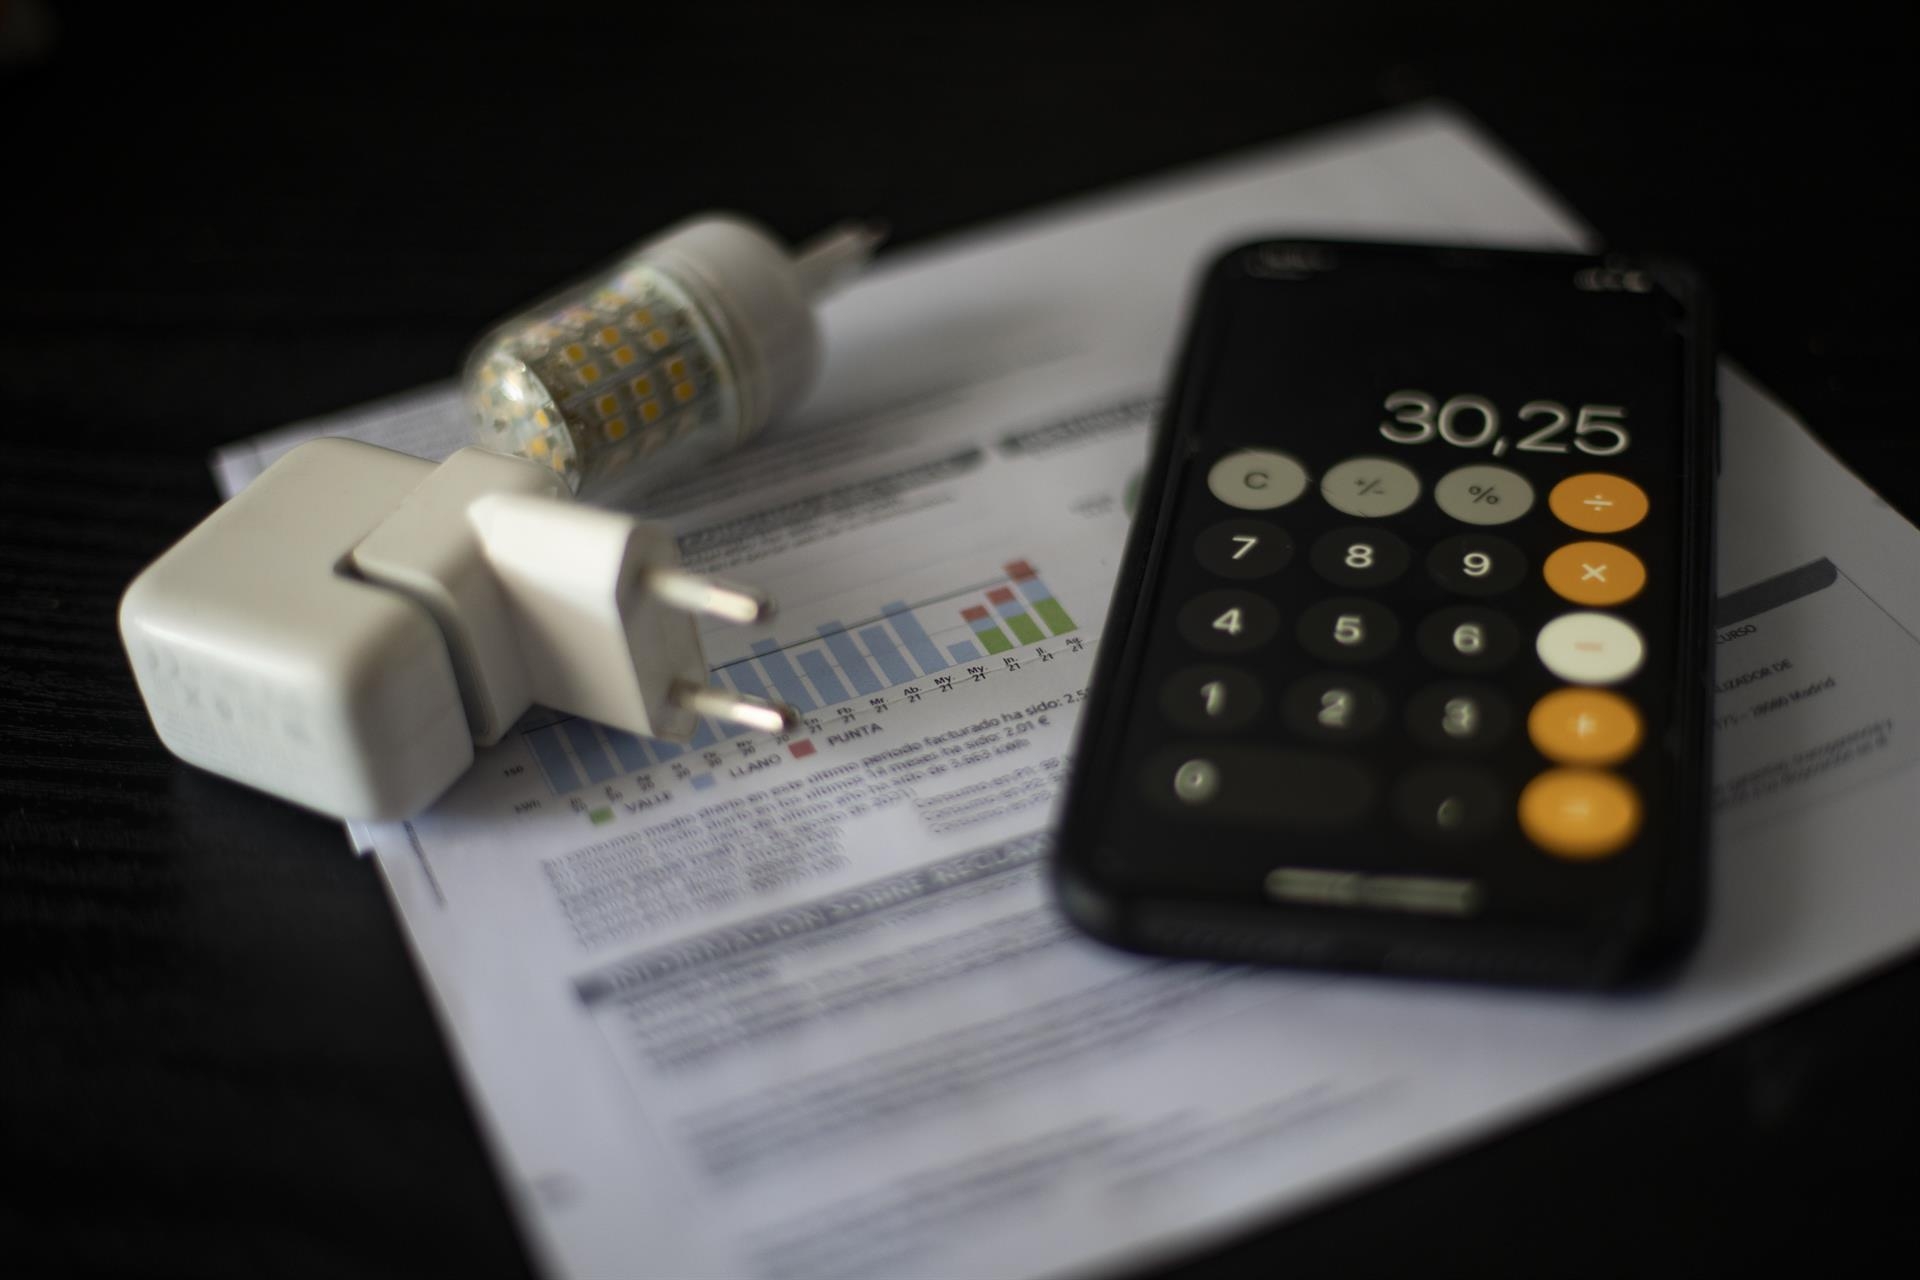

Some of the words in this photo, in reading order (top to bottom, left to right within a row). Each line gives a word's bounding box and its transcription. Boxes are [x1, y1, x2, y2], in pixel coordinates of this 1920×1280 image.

[1379, 390, 1631, 457] 30,25
[1243, 471, 1270, 490] C
[1231, 535, 1258, 560] 7
[1344, 544, 1374, 569] 8
[1462, 552, 1491, 577] 9
[1212, 608, 1243, 636] 4
[1333, 616, 1364, 644] 5
[1452, 623, 1483, 653] 6
[875, 704, 889, 713] 21
[907, 693, 922, 703] 21
[941, 683, 953, 693] 21
[972, 672, 986, 682] 21
[1008, 662, 1021, 672] 21
[1041, 652, 1054, 662] 21
[1071, 643, 1084, 653] 21
[903, 686, 922, 696] Ab.
[1200, 680, 1226, 716] 1
[1317, 688, 1351, 728] 2
[924, 716, 999, 748] facturado
[1001, 709, 1022, 723] ha
[1025, 698, 1063, 716] sido:
[1037, 714, 1049, 727] €
[1441, 697, 1479, 736] 3
[827, 722, 884, 746] PUNTA
